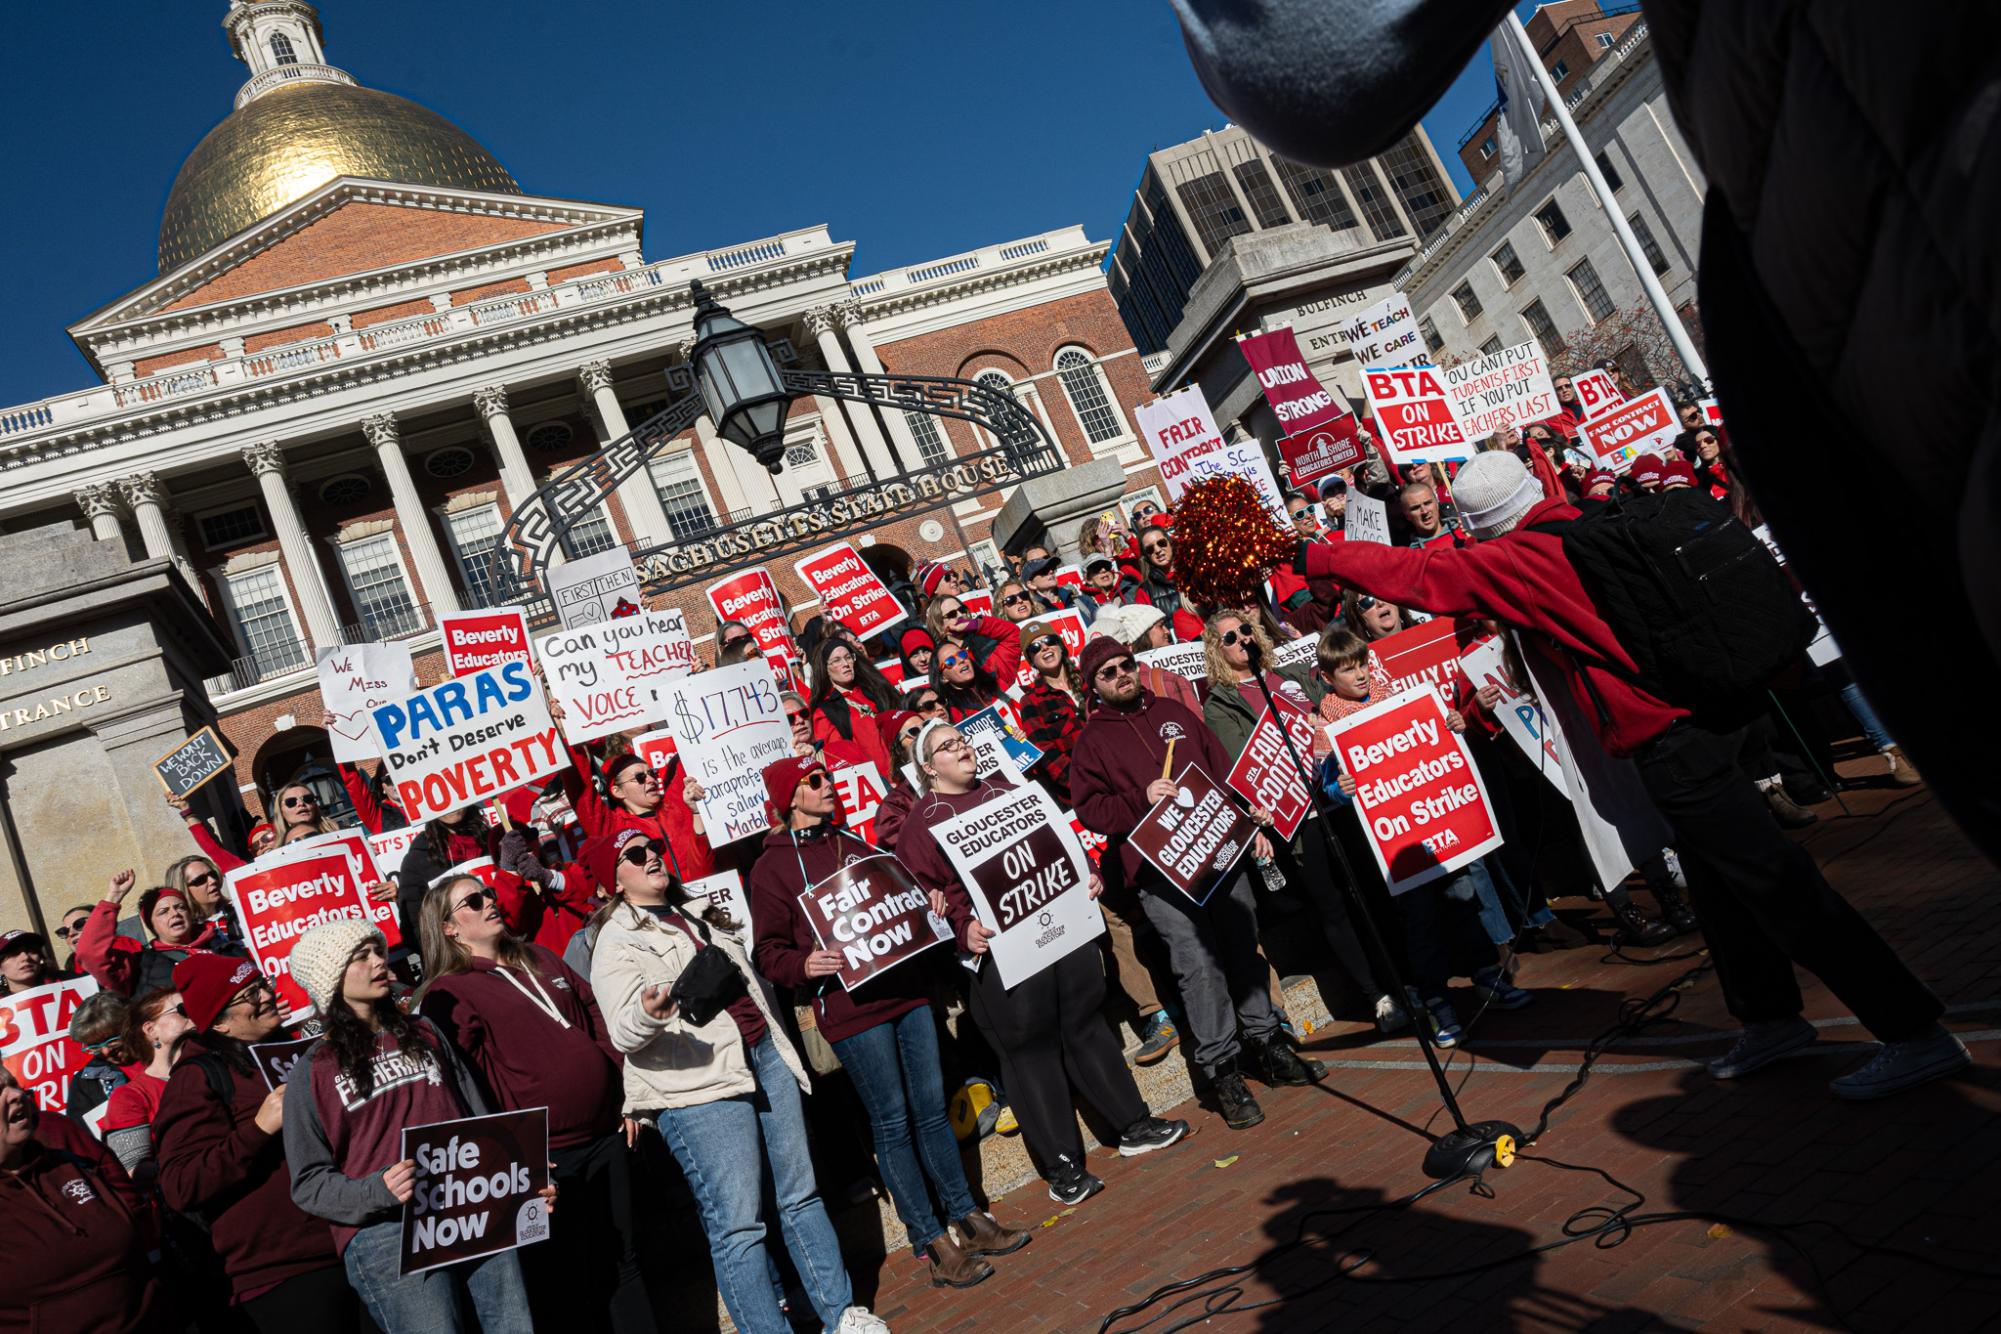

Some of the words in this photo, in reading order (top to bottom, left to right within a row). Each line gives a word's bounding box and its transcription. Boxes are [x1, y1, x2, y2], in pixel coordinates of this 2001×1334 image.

[1295, 290, 1367, 317] BULFINCH
[1309, 331, 1348, 350] ENTR
[1345, 321, 1371, 343] WE
[1371, 307, 1410, 332] TEACH
[1355, 344, 1382, 365] WE
[1384, 331, 1416, 353] CARE
[1443, 366, 1468, 384] OU
[1505, 341, 1533, 364] PUT
[1257, 361, 1309, 390] UNION
[1367, 371, 1446, 400] BTA
[1450, 373, 1503, 401] TUDENTS
[1503, 358, 1540, 383] FIRST
[1577, 374, 1620, 407] BTA
[1274, 390, 1332, 422] STRONG
[1402, 402, 1430, 424] ON
[1458, 397, 1476, 416] IF
[1480, 389, 1505, 408] YOU
[1506, 378, 1531, 400] PUT
[1463, 405, 1516, 437] EACHERS
[1516, 392, 1552, 419] LAST
[1158, 416, 1206, 449] FAIR
[1393, 422, 1460, 449] STRIKE
[1589, 424, 1611, 438] FAIR
[1612, 399, 1660, 425] CONTRACT
[1598, 410, 1658, 449] NOW
[1295, 450, 1320, 466] NORTH
[1327, 437, 1352, 455] SHORE
[1298, 456, 1333, 475] EDUCATORS
[1333, 448, 1354, 463] UNITED
[635, 511, 823, 585] SACHUSETTS
[831, 488, 909, 526] STATE
[917, 456, 1010, 501] HOUSE
[1356, 505, 1382, 531] MAKE
[562, 583, 595, 604] FIRST
[599, 573, 631, 592] THEN
[811, 556, 860, 585] Beverly
[821, 573, 875, 605] Educators
[721, 584, 774, 616] Beverly
[831, 603, 853, 620] On
[851, 587, 887, 610] Strike
[859, 610, 880, 627] BTA
[452, 625, 518, 647] Beverly
[544, 633, 596, 659] Can
[604, 624, 643, 654] you
[649, 615, 683, 633] hear
[0, 637, 92, 676] FINCH
[453, 650, 529, 669] Educators
[559, 659, 598, 686] my
[605, 640, 695, 671] TEACHER
[1152, 651, 1206, 669] OUCESTER
[0, 685, 112, 731] TRANCE
[372, 661, 532, 749] PARAS
[573, 686, 641, 720] VOICE
[674, 679, 778, 744] $17,743
[388, 738, 440, 770] Don't
[449, 714, 526, 752] Deserve
[1248, 721, 1284, 769] FAIR
[1348, 716, 1440, 772] Beverly
[159, 757, 178, 773] WE
[176, 747, 211, 777] BACK
[180, 754, 223, 790] DOWN
[397, 727, 557, 822] POVERTY
[703, 758, 718, 778] is
[722, 745, 748, 771] the
[1245, 767, 1258, 782] GTA
[1356, 751, 1464, 811] Educators
[946, 794, 1042, 845] GLOUCESTER
[1157, 805, 1185, 832] WE
[1158, 788, 1225, 868] GLOUCESTER
[1374, 815, 1411, 841] On
[1410, 783, 1479, 825] Strike
[960, 809, 1047, 858] EDUCATORS
[1175, 805, 1238, 881] EDUCATORS
[1422, 828, 1459, 856] BTA
[1003, 840, 1036, 880] ON
[247, 872, 345, 914] Beverly
[817, 876, 872, 922] Fair
[999, 857, 1071, 926] STRIKE
[252, 904, 363, 949] Educators
[843, 920, 913, 971] Now
[23, 1041, 65, 1080] ON
[416, 1135, 480, 1179] Safe
[414, 1162, 530, 1217] Schools
[412, 1211, 489, 1253] Now
